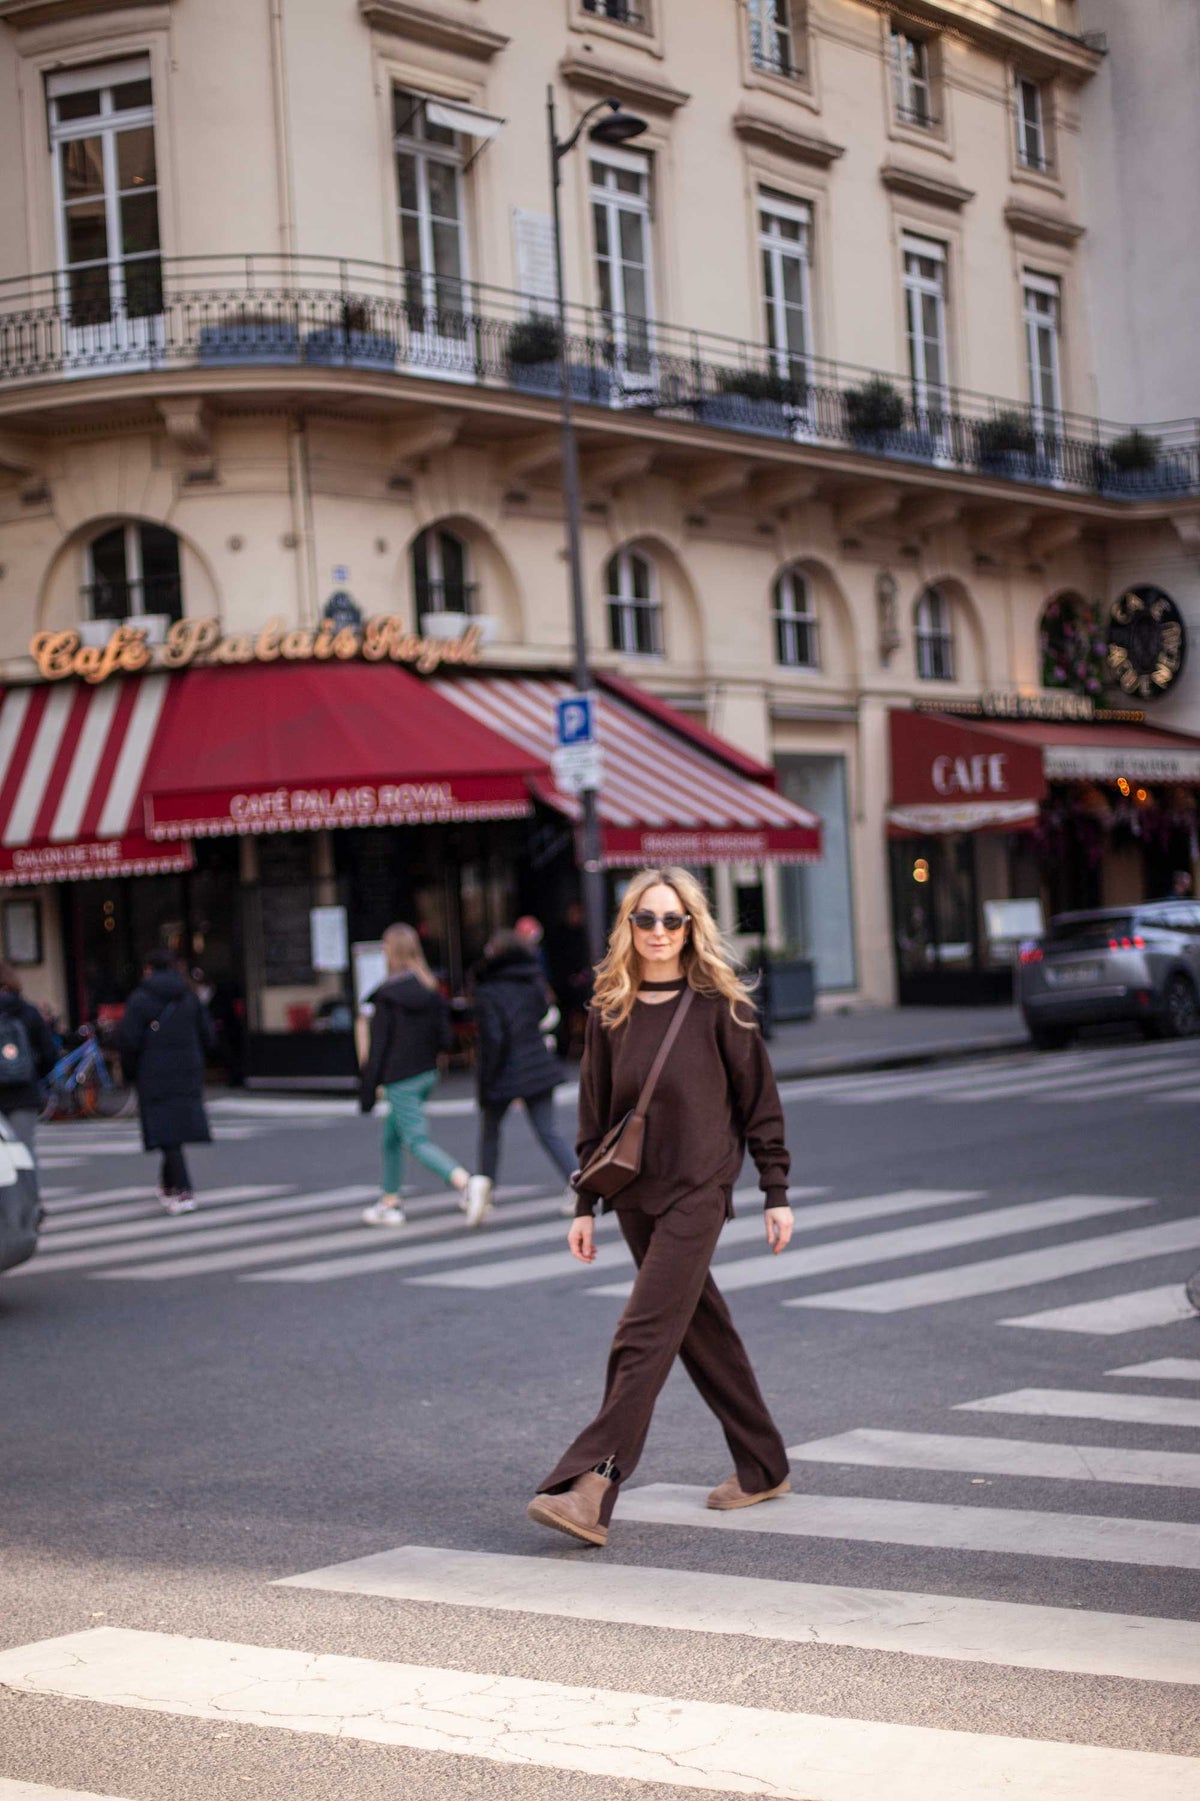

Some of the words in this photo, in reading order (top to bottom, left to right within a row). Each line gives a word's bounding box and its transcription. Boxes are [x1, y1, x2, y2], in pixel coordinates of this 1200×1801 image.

[30, 624, 150, 684] Café
[164, 616, 359, 667] Palais
[362, 615, 481, 674] Royal
[563, 704, 586, 738] P
[230, 786, 289, 821] CAFÉ
[291, 784, 378, 815] PALAIS
[378, 781, 457, 809] ROYAL
[13, 848, 65, 869] SALON
[66, 846, 88, 864] DE
